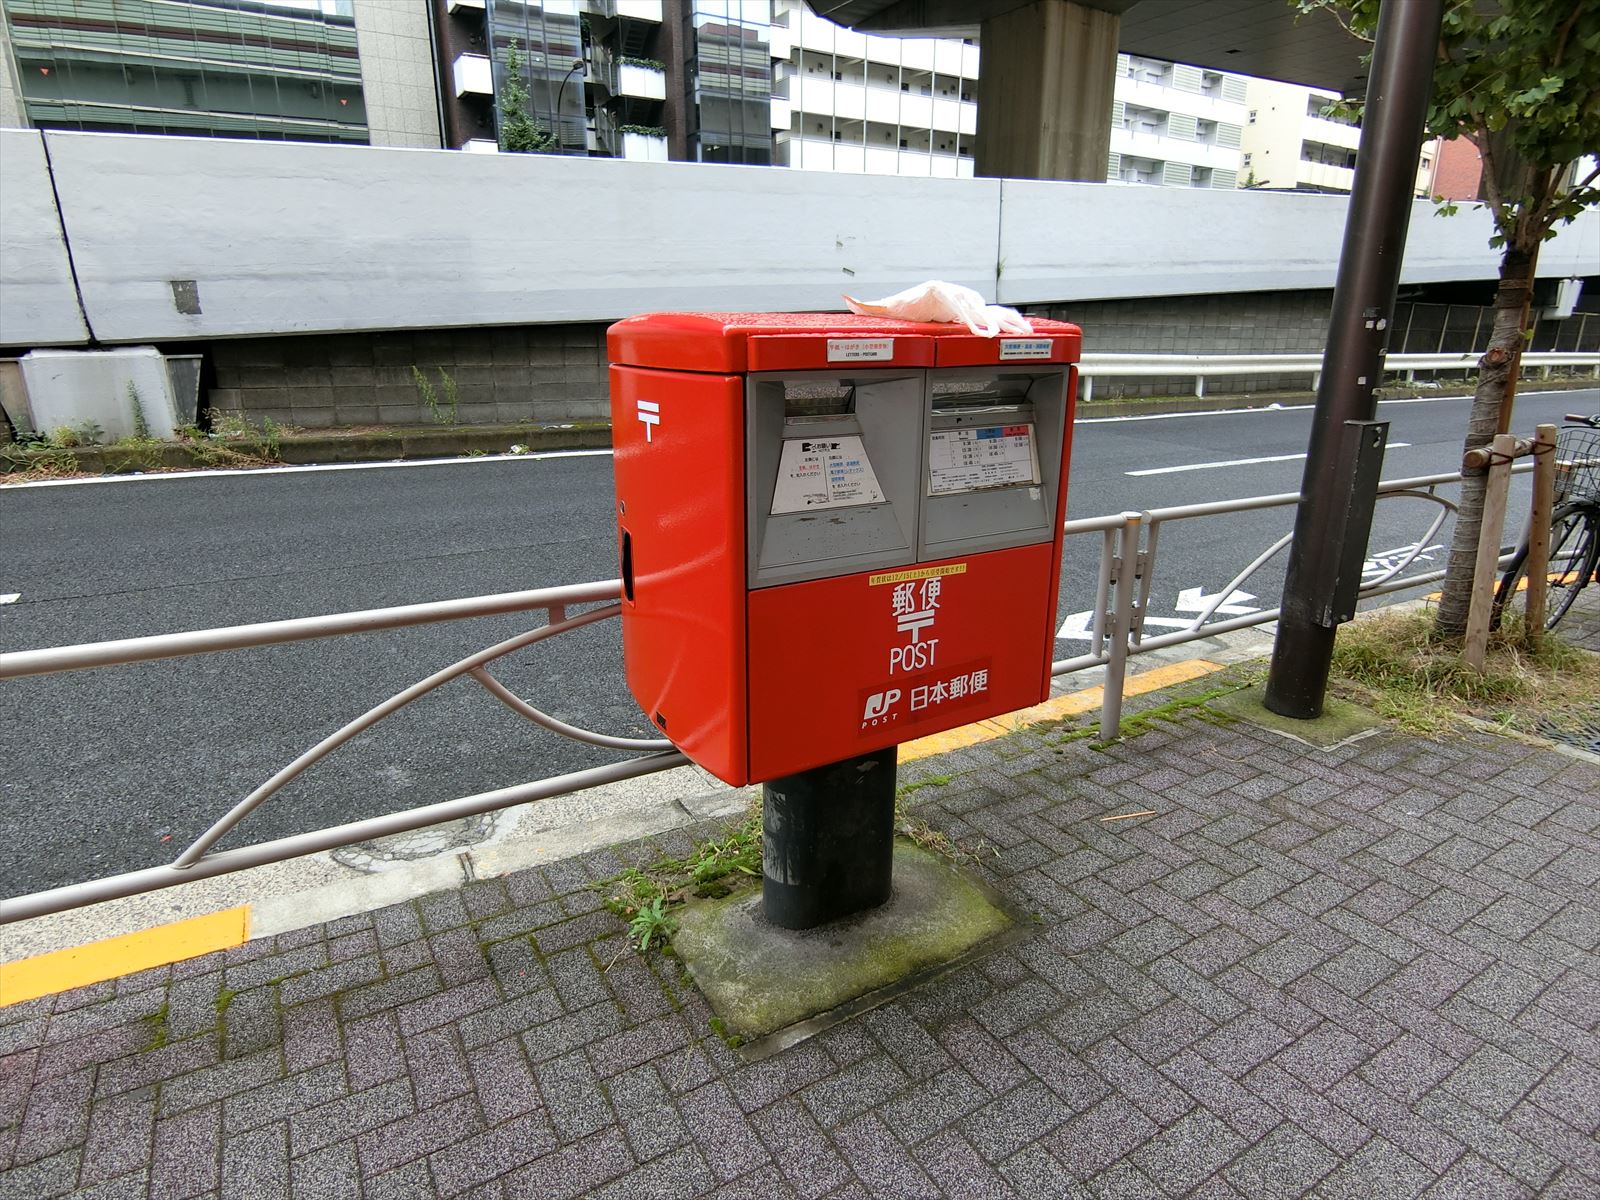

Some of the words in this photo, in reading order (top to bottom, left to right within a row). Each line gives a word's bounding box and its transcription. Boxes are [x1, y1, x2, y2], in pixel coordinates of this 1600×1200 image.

[892, 576, 942, 617] 郵便
[889, 639, 939, 675] POST
[910, 669, 989, 712] 日本郵便
[861, 713, 898, 729] POST
